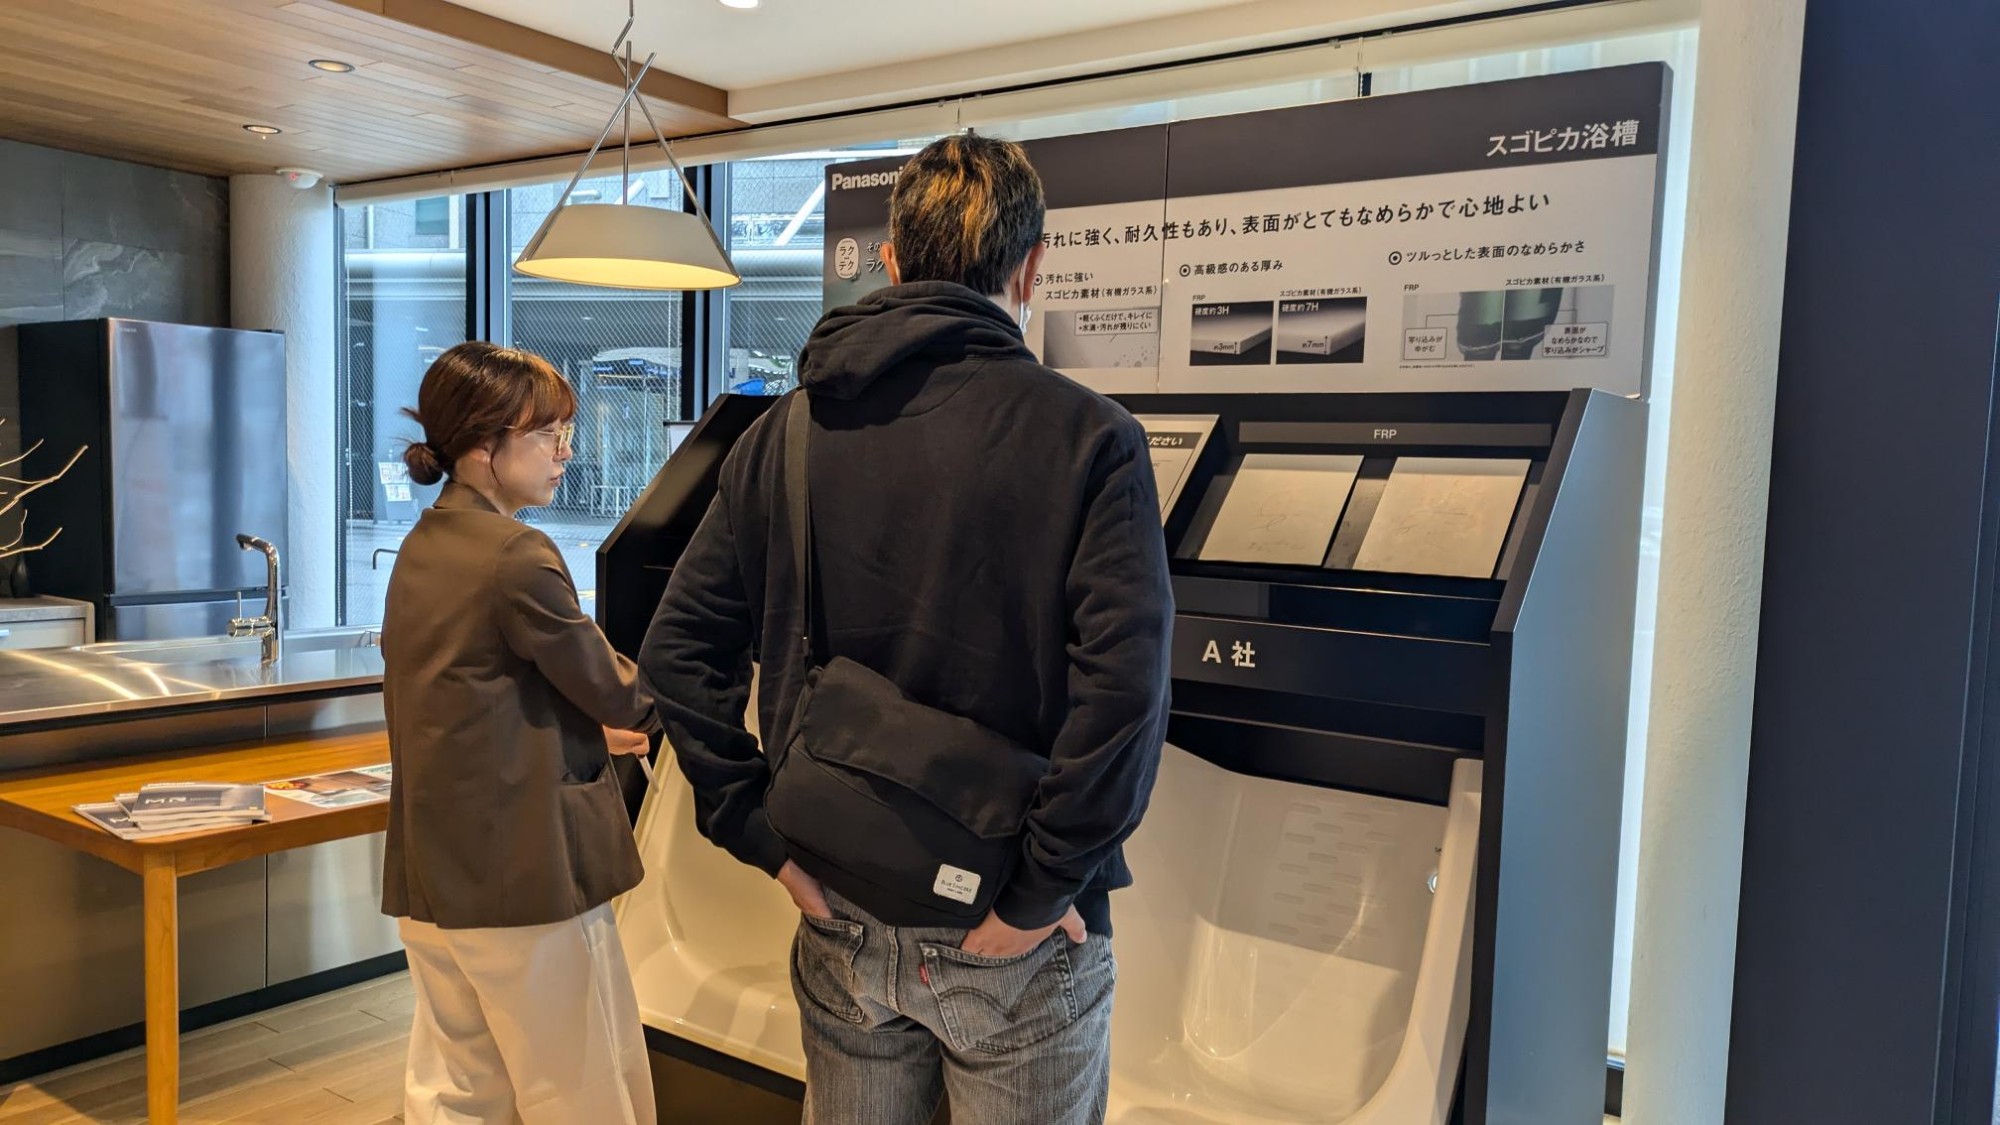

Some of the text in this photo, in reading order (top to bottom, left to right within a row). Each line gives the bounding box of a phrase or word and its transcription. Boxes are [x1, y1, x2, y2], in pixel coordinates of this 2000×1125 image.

[1486, 119, 1640, 157] スゴピカ浴槽
[1406, 240, 1586, 263] ツルっとした表面のなめらかさ
[1194, 259, 1284, 276] 高級感のある厚み
[1045, 272, 1094, 285] 汚れに強い
[1404, 284, 1420, 292] FRP
[1147, 436, 1183, 446] ださい
[1373, 428, 1397, 439] FRP
[1201, 640, 1256, 668] A 社
